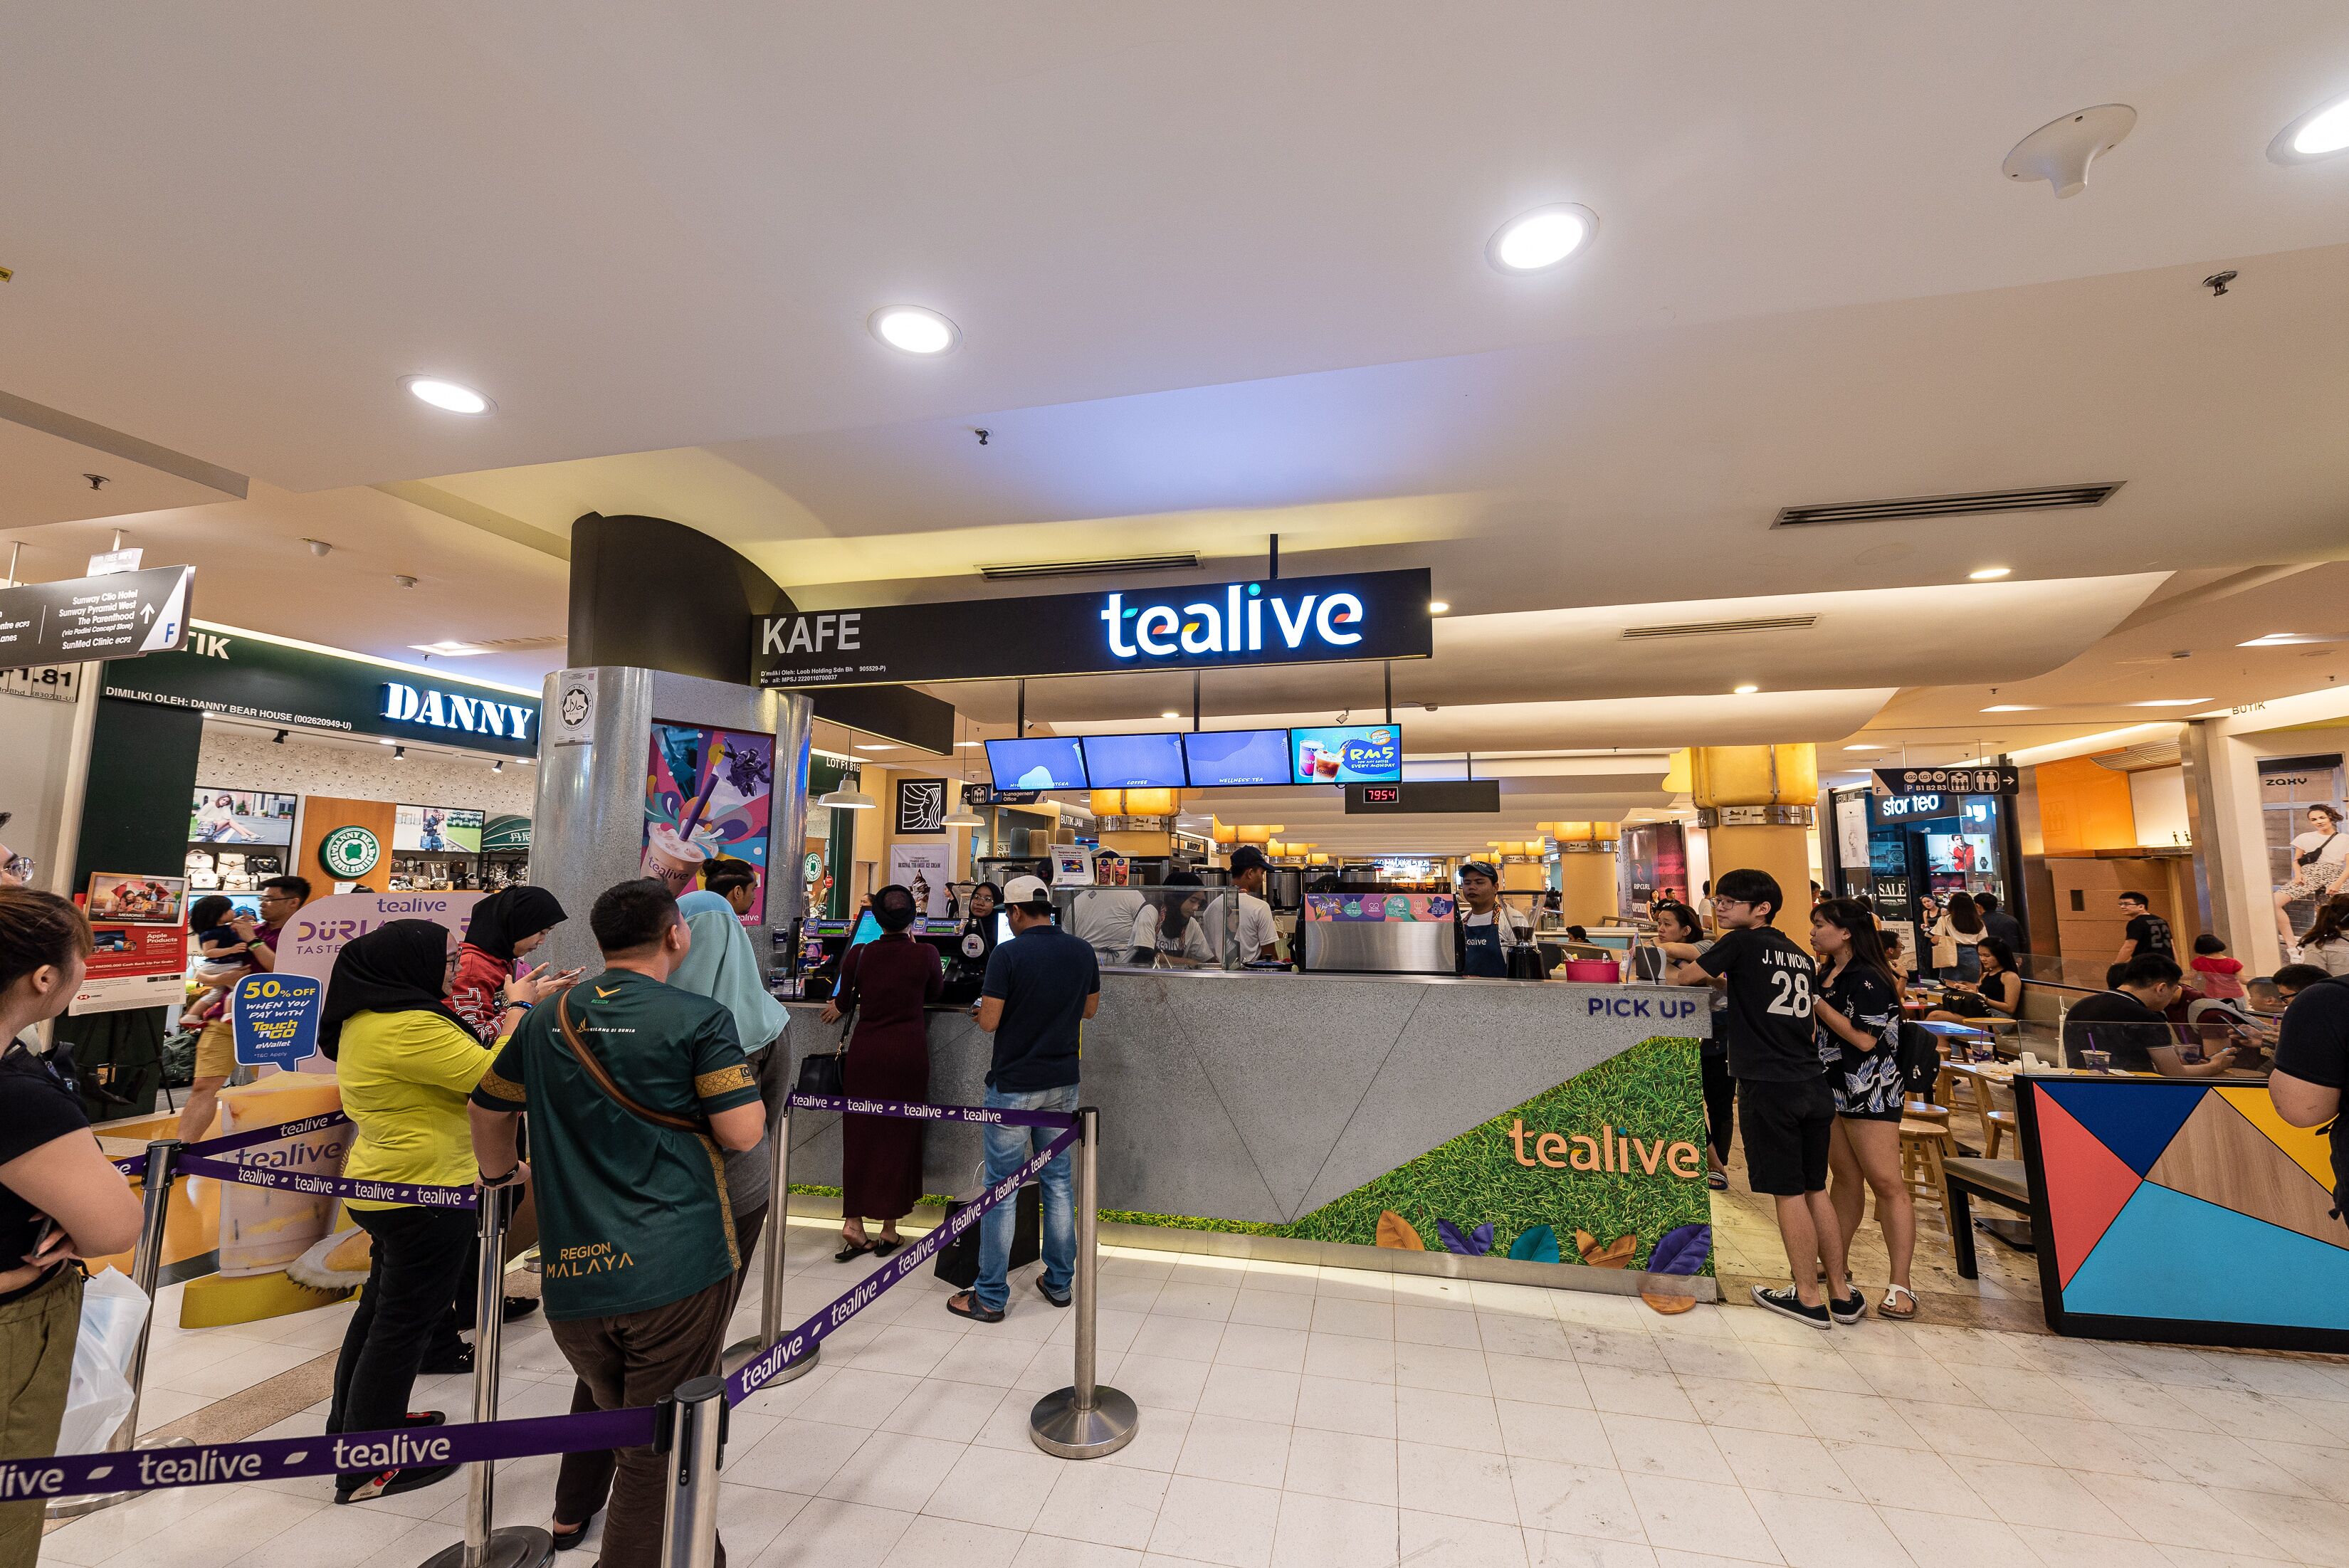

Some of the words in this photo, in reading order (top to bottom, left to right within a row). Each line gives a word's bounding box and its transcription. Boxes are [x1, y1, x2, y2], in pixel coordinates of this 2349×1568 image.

[73, 595, 100, 605] Sunway
[102, 592, 116, 602] Clio
[118, 589, 138, 599] Hotel
[59, 606, 86, 617] Sunway
[88, 603, 117, 615] Pyramid
[119, 600, 137, 610] West
[93, 611, 135, 624] Parenthood
[0, 621, 14, 630] ntre
[92, 625, 116, 634] Concept
[1100, 584, 1363, 658] tealive
[165, 623, 175, 643] F
[762, 613, 861, 655] KAFE
[62, 640, 91, 650] SunMed
[93, 636, 114, 646] Clinic
[106, 686, 152, 702] DIMILIKI
[154, 693, 189, 707] OLEH:
[191, 699, 228, 712] DANNY
[229, 705, 257, 717] BEAR
[259, 709, 293, 722] HOUSE
[294, 715, 352, 731] (002620949-U)
[382, 681, 533, 740] DANNY
[2232, 700, 2266, 715] BUTIK
[1350, 747, 1394, 761] RM5
[826, 757, 840, 769] LOT
[841, 759, 861, 773] F181B
[1368, 790, 1396, 800] 7954
[1061, 814, 1074, 826] BUTIK
[1074, 818, 1083, 828] JAM
[648, 856, 689, 881] tealive
[1878, 883, 1907, 896] SALE
[377, 898, 447, 912] tealive
[1762, 949, 1772, 964] J.
[1775, 950, 1787, 967] W.
[243, 980, 291, 999] 50%
[293, 988, 315, 996] OFF
[1767, 970, 1812, 1019] 28
[246, 1001, 283, 1009] WHEN
[1588, 996, 1651, 1018] PICK
[1660, 999, 1696, 1019] UP
[252, 1019, 298, 1031] Touch
[255, 1040, 291, 1049] eWallet
[792, 1094, 827, 1109] tealive
[846, 1099, 883, 1114] tealive
[903, 1103, 942, 1119] tealive
[962, 1107, 1002, 1124] tealive
[280, 1115, 328, 1137] tealive
[236, 1139, 343, 1169] tealive
[1508, 1118, 1700, 1179] tealive
[238, 1166, 276, 1186] tealive
[294, 1174, 334, 1194] tealive
[355, 1180, 395, 1201] tealive
[417, 1186, 461, 1206] tealive
[560, 1241, 611, 1260] REGION
[546, 1251, 634, 1278] MALAYA
[742, 1337, 803, 1395] tealive
[831, 1280, 877, 1327] tealive
[898, 1236, 935, 1276] tealive
[952, 1203, 982, 1236] tealive
[994, 1173, 1019, 1202] tealive
[1031, 1148, 1052, 1174] tealive
[0, 1463, 64, 1496] live
[139, 1449, 261, 1485] tealive
[332, 1434, 451, 1470] tealive
